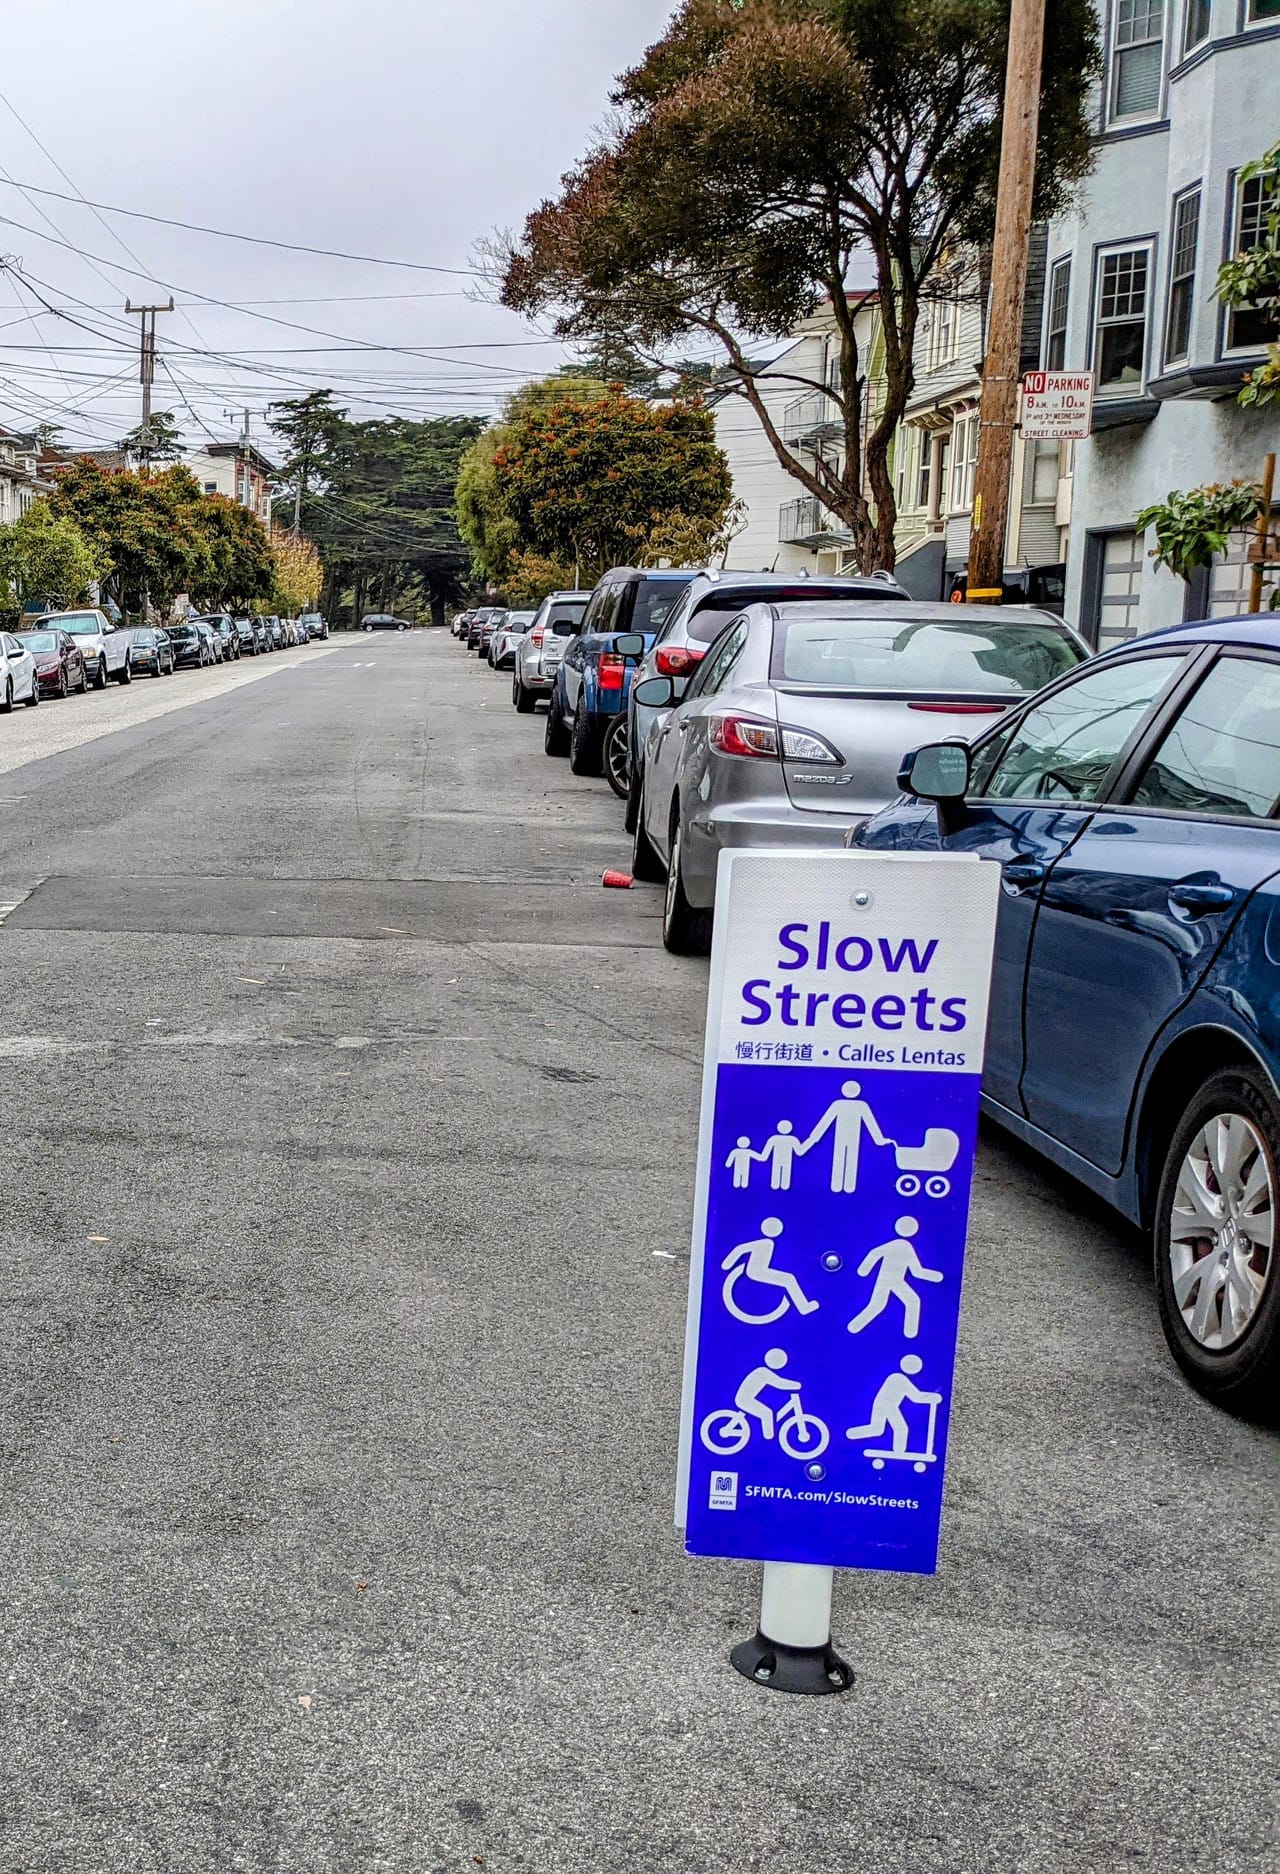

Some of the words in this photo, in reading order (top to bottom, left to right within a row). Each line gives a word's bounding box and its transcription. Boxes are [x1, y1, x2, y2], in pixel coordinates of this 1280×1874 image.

[1024, 374, 1044, 392] NO
[1047, 378, 1090, 391] PARKING
[1051, 429, 1084, 437] CLEANING
[777, 921, 939, 973] Slow
[740, 979, 968, 1033] Streets
[735, 1040, 814, 1062] 慢行街道
[838, 1044, 895, 1063] Calles
[901, 1046, 966, 1066] Lentas
[744, 1485, 919, 1510] SFMTA.com/SlowStreets
